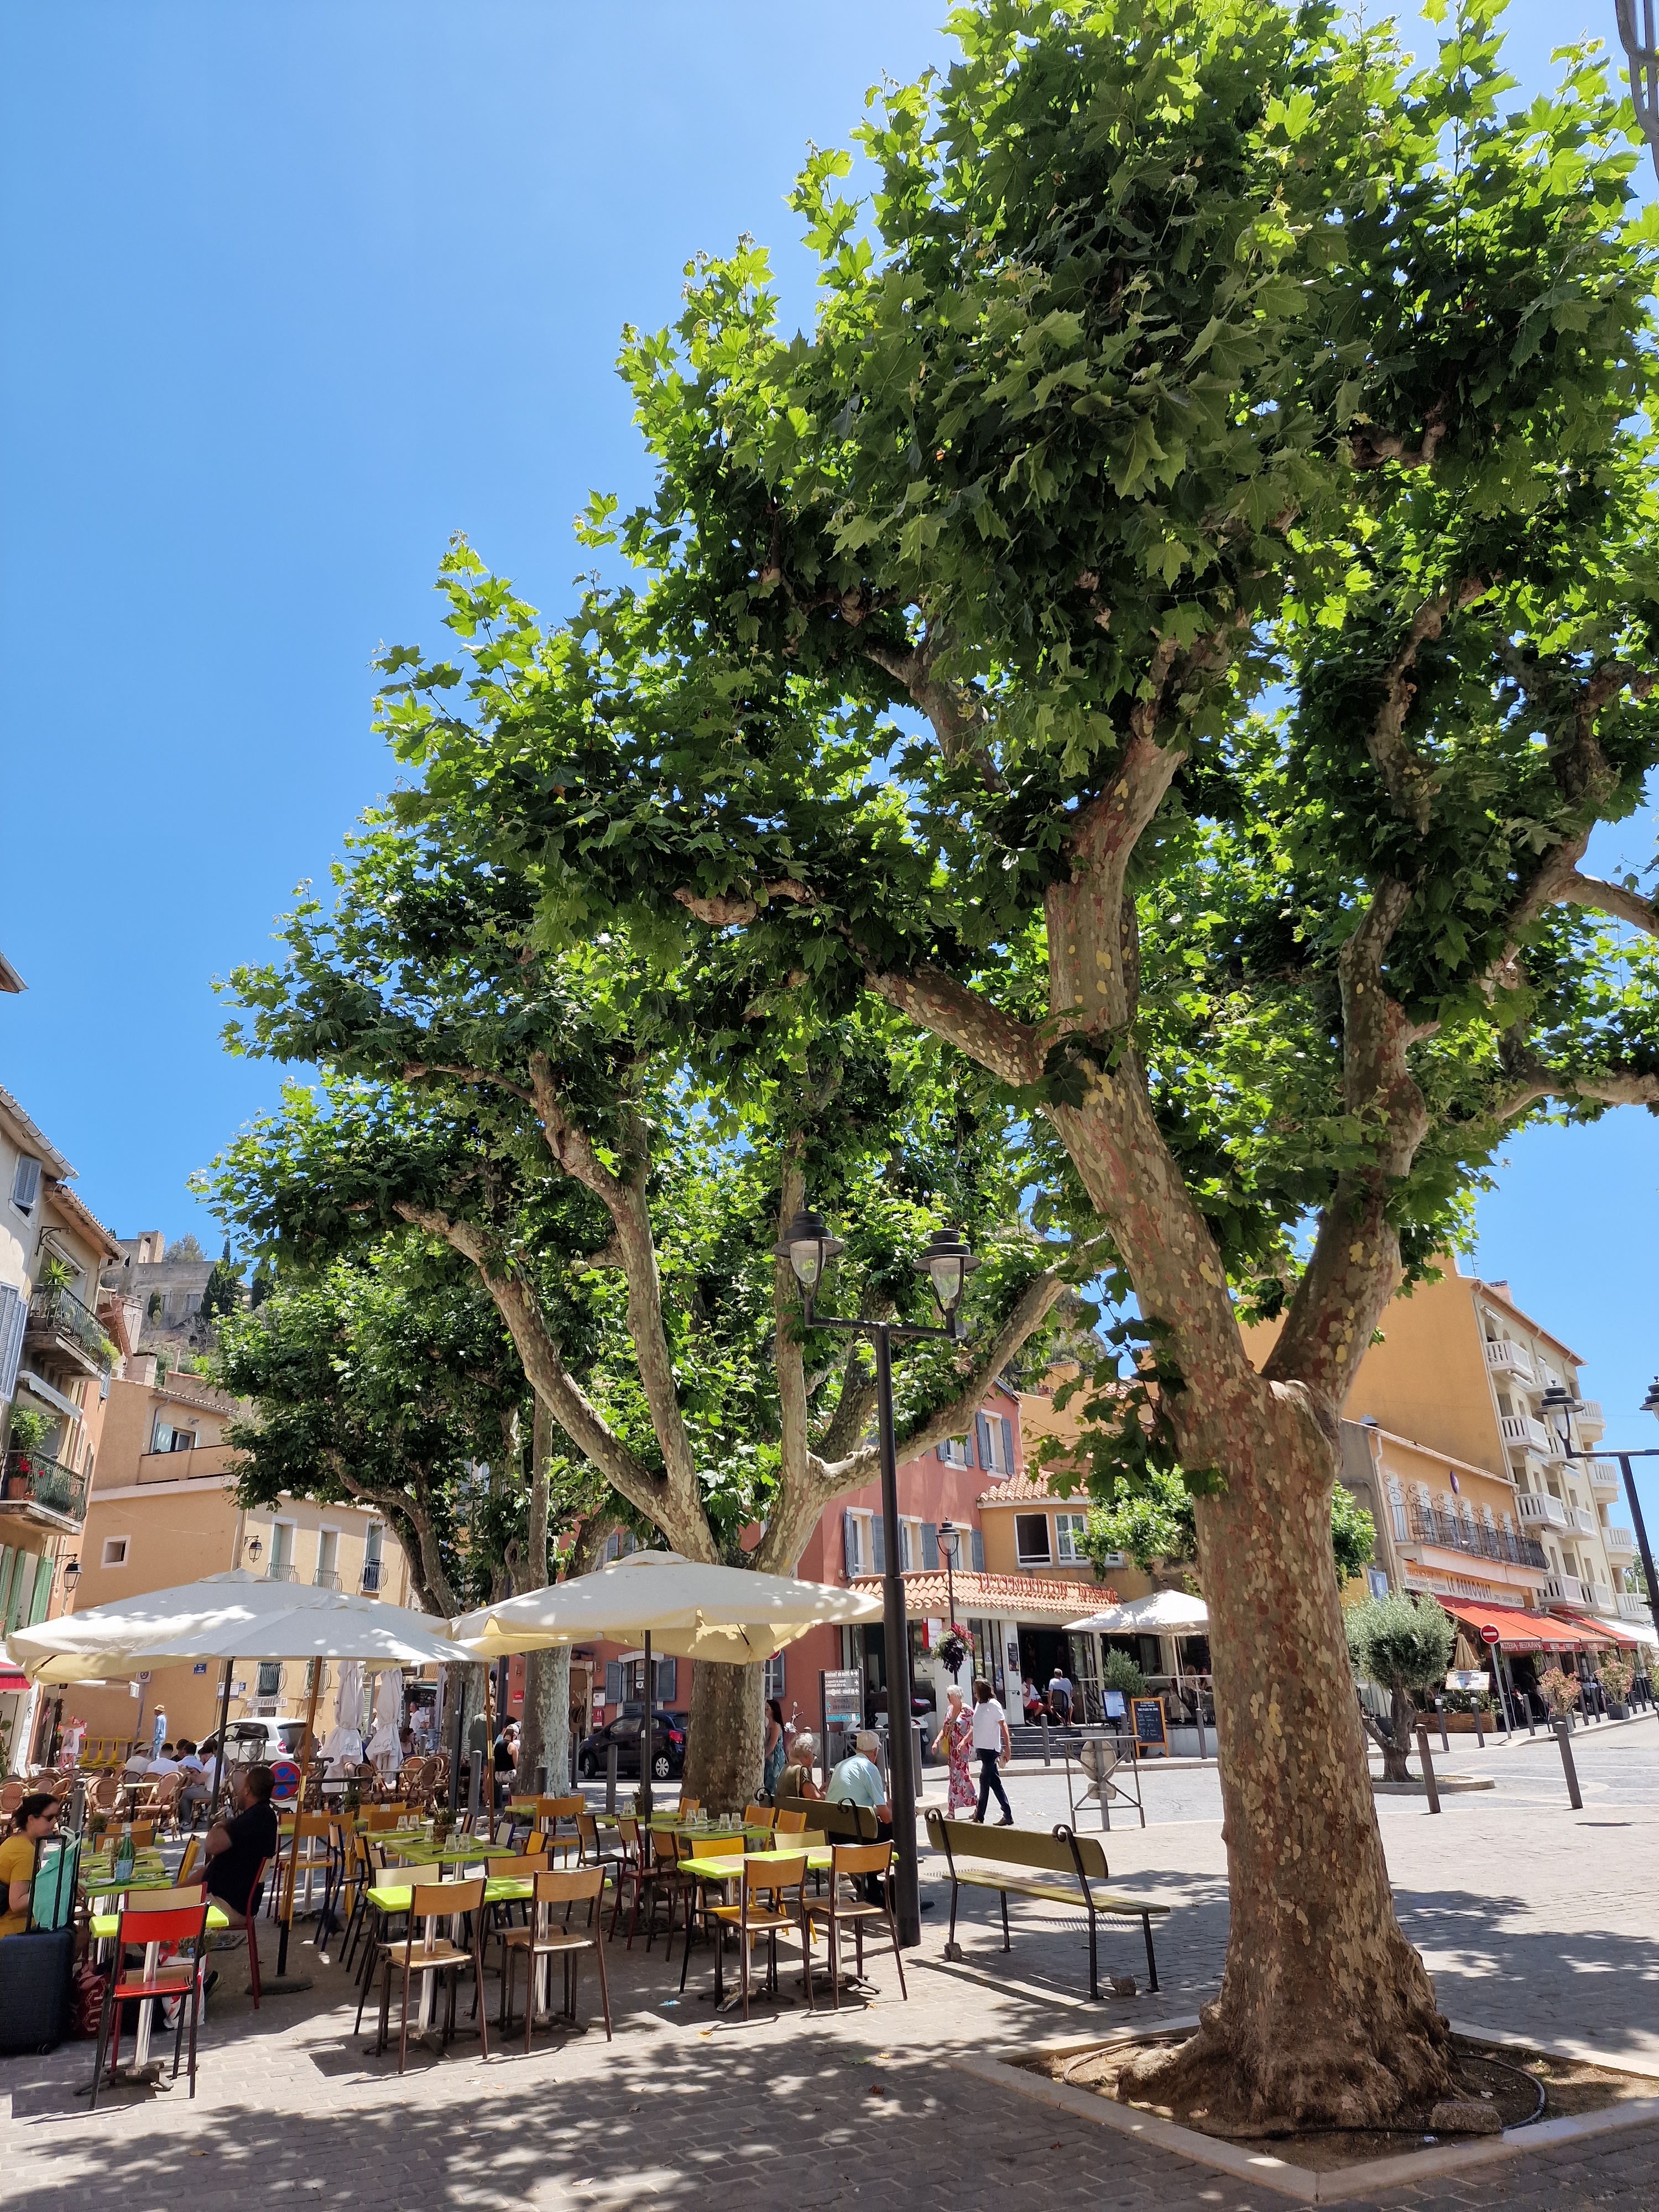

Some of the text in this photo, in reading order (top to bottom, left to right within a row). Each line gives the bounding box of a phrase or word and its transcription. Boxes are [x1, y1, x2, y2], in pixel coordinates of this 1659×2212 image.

[979, 1572, 1118, 1601] LE CENDRILLON brasserie
[1446, 1575, 1491, 1599] LE PERROQUET
